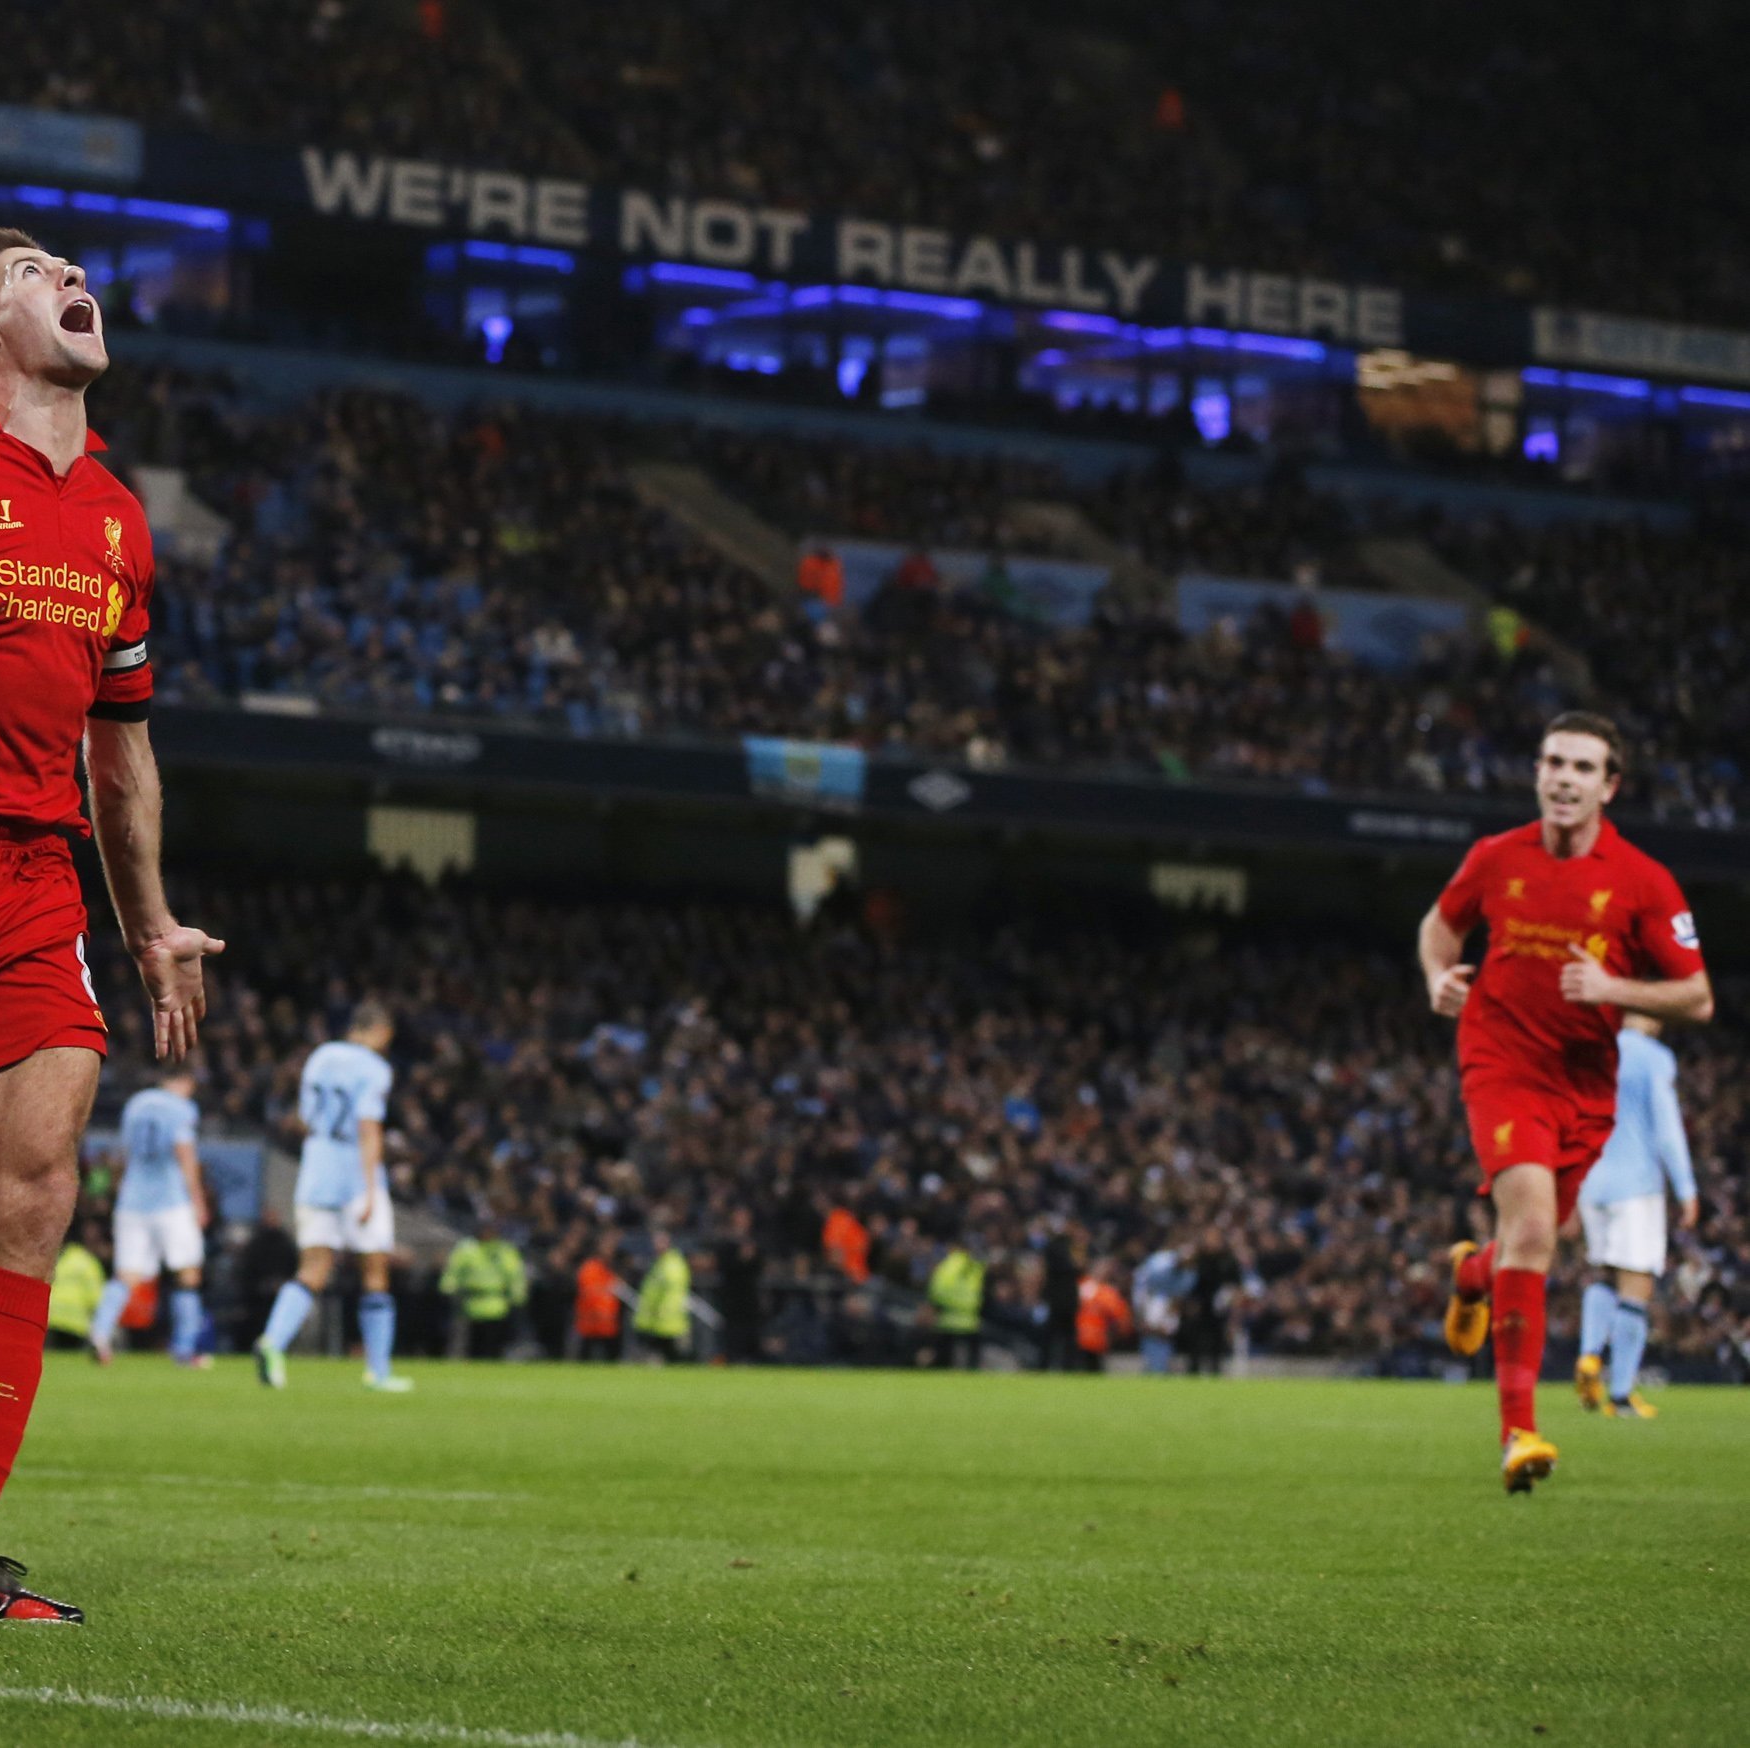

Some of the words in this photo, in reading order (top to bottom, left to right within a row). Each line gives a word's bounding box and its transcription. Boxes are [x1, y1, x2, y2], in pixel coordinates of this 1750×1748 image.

[302, 147, 590, 243] WE'RE
[620, 189, 810, 271] NOT
[836, 218, 1159, 315] REALLY
[1186, 265, 1408, 344] HERE
